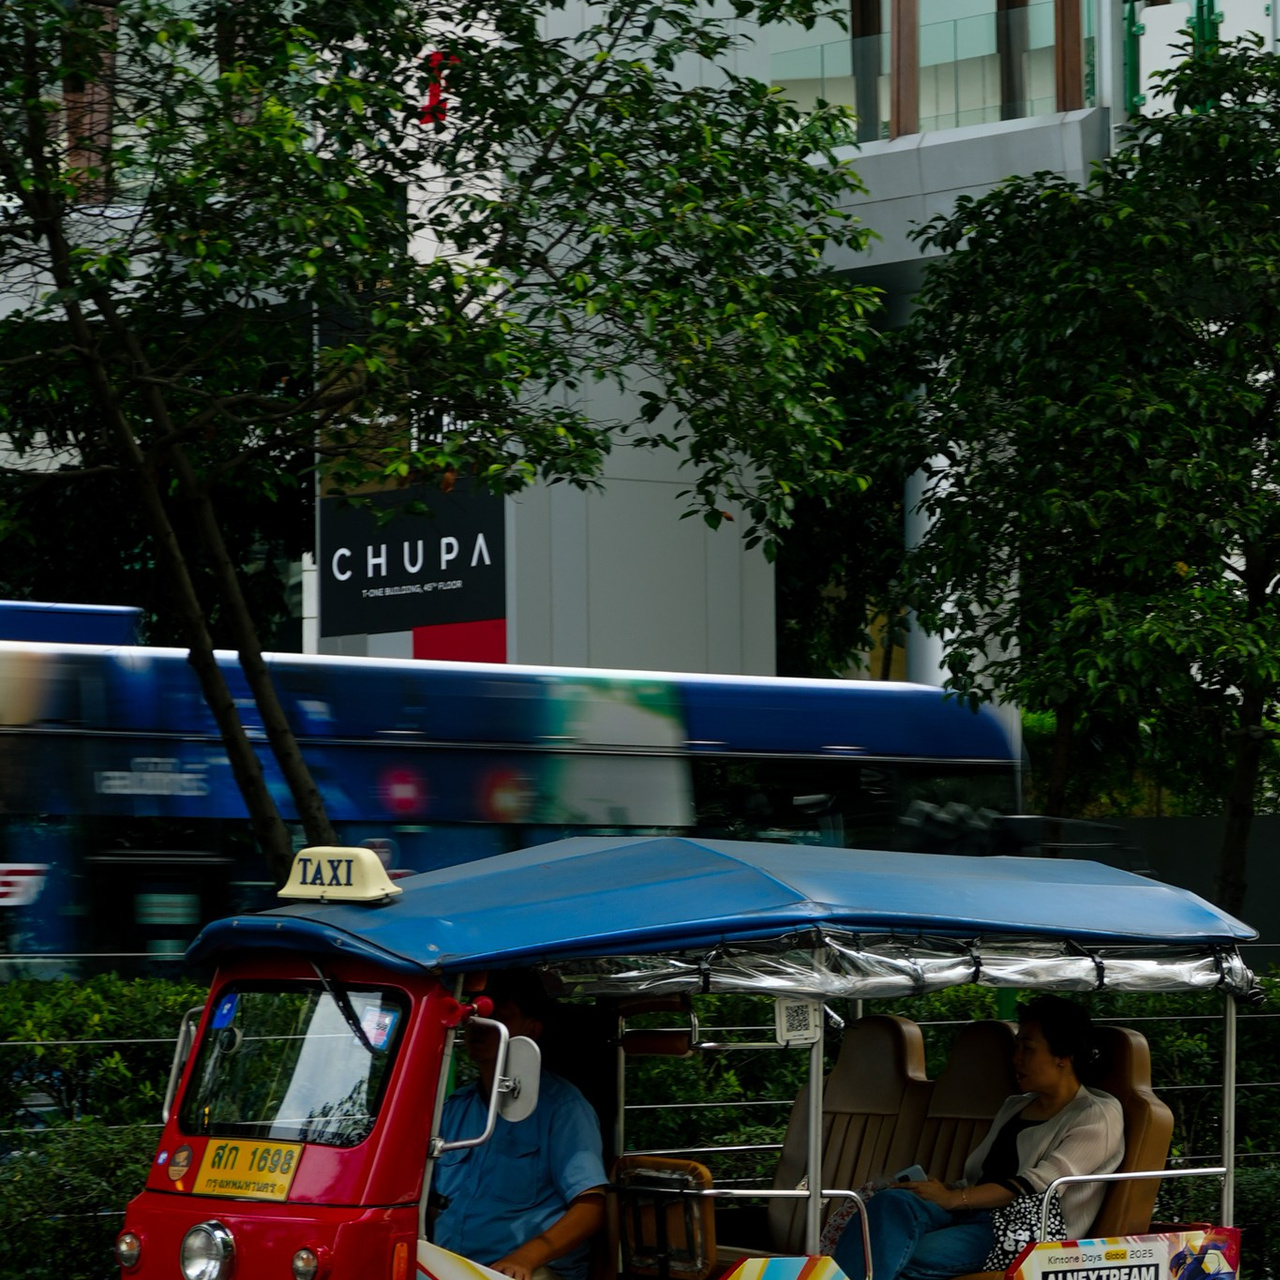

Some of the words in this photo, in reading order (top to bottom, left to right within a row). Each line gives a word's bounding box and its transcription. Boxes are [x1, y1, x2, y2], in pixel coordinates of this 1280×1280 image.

[332, 532, 491, 581] CHUPA
[297, 858, 353, 886] TAXI
[249, 1147, 294, 1174] 1698
[1048, 1255, 1079, 1264] Kintone
[1082, 1253, 1102, 1263] Days
[1104, 1250, 1127, 1261] Global
[1129, 1249, 1153, 1259] 2025
